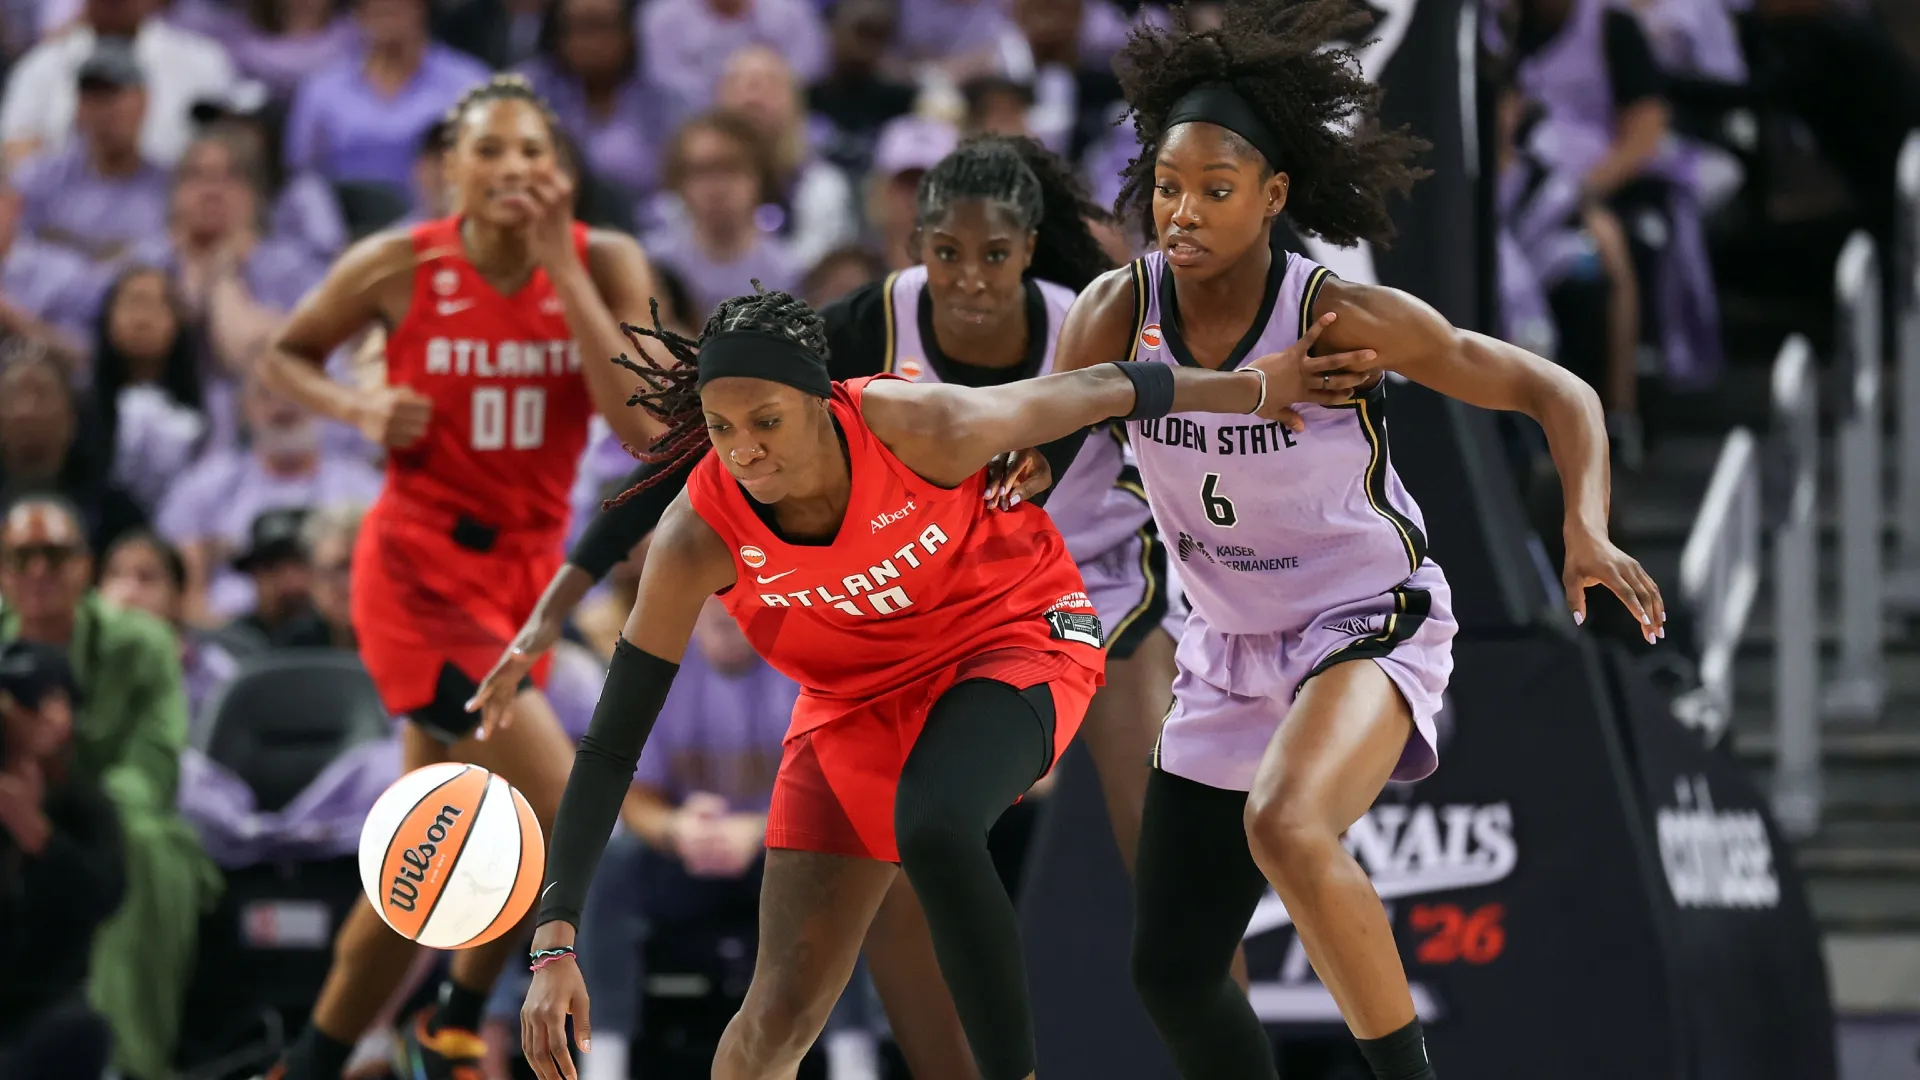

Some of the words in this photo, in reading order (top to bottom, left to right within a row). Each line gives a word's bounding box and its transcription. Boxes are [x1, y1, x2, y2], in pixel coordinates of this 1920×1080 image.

[471, 386, 546, 450] 00
[1140, 417, 1207, 453] OLDEN
[1217, 421, 1297, 455] STATE
[870, 500, 917, 535] Albert
[1200, 472, 1239, 529] 6
[760, 522, 949, 608] ATLANTA
[1216, 545, 1256, 557] KAISER
[389, 804, 464, 913] Wilson
